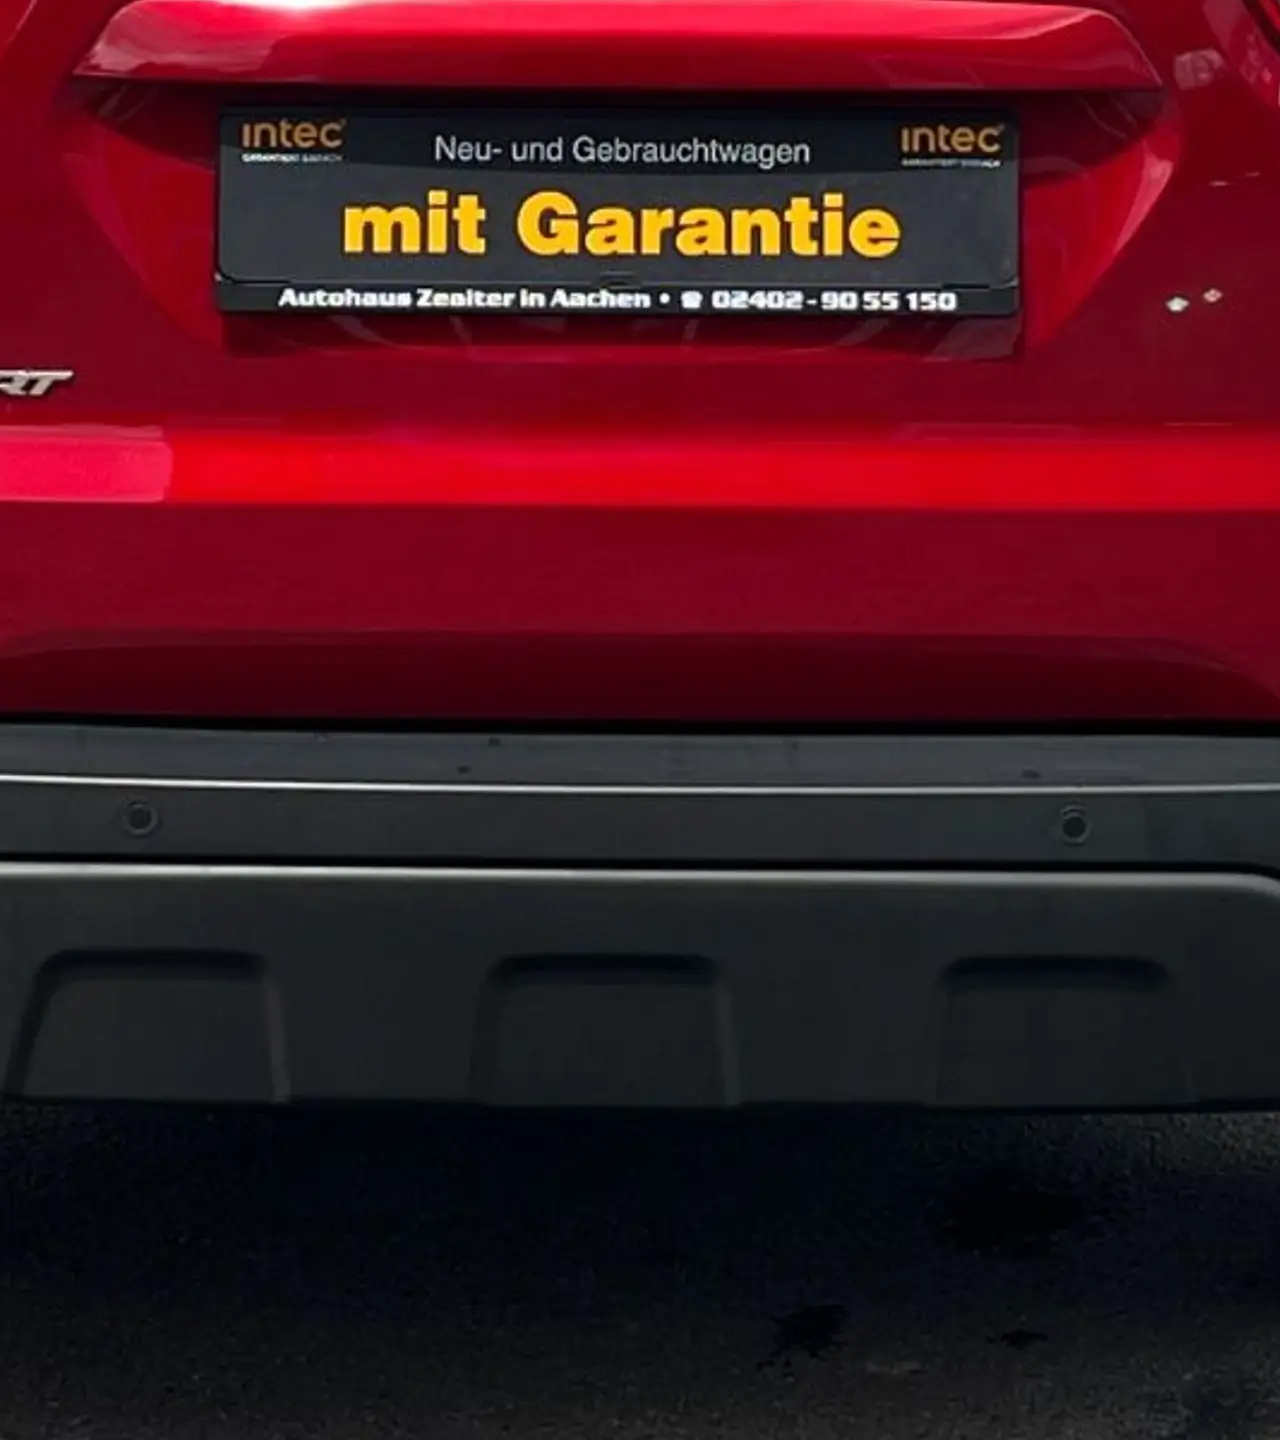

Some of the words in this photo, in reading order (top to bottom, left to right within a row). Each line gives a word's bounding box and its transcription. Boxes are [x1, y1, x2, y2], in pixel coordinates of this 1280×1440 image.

[242, 118, 342, 148] intec
[901, 123, 1002, 153] intec
[434, 135, 503, 161] Neu-
[513, 136, 563, 163] und
[571, 136, 811, 168] Gebrauchtwagen
[342, 189, 486, 254] mit
[517, 190, 902, 258] Garantie
[278, 288, 412, 308] Autohaus
[521, 288, 546, 308] in
[551, 289, 652, 309] Aachen
[711, 290, 804, 310] 02402
[821, 291, 858, 311] 90
[862, 291, 899, 311] 55
[906, 291, 957, 311] 150
